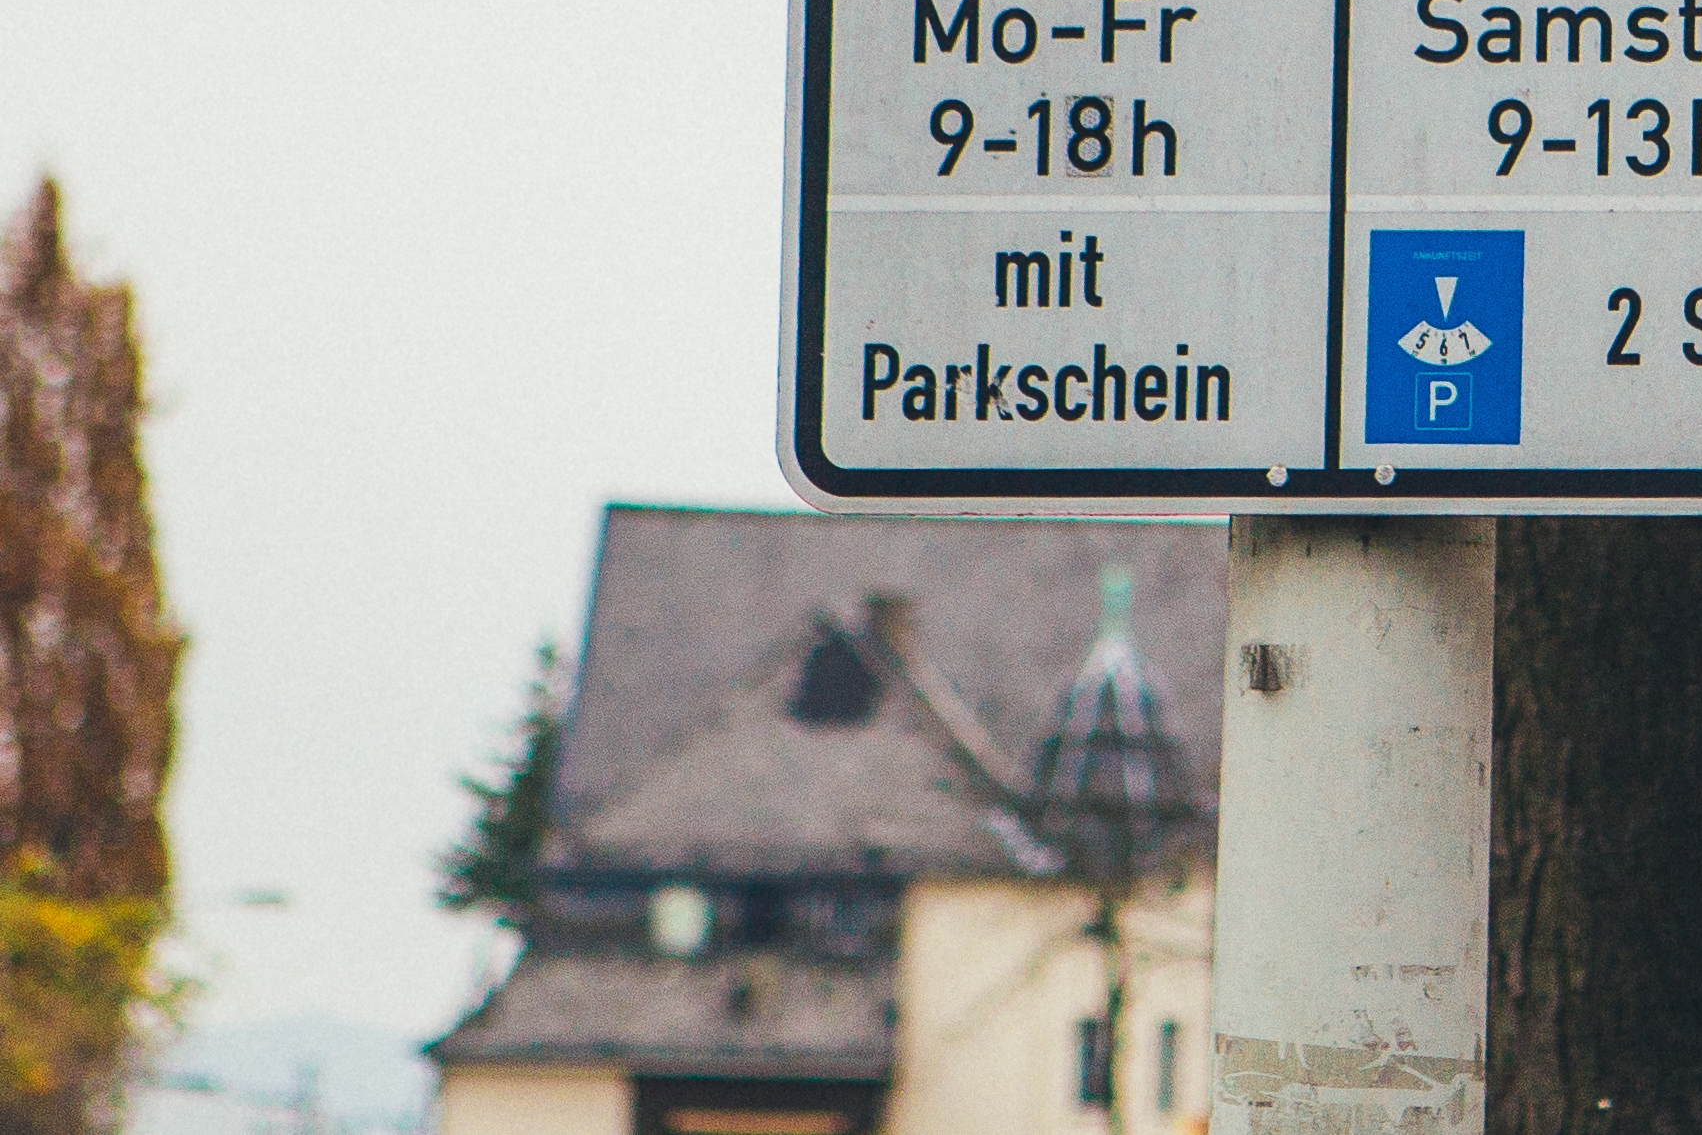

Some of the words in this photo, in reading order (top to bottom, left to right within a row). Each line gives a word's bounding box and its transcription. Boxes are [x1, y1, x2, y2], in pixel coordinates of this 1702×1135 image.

[930, 96, 1177, 177] 9-18h
[996, 230, 1104, 308] mit
[1606, 287, 1642, 366] 2
[863, 344, 1231, 422] Parkschein
[1429, 380, 1458, 421] P
